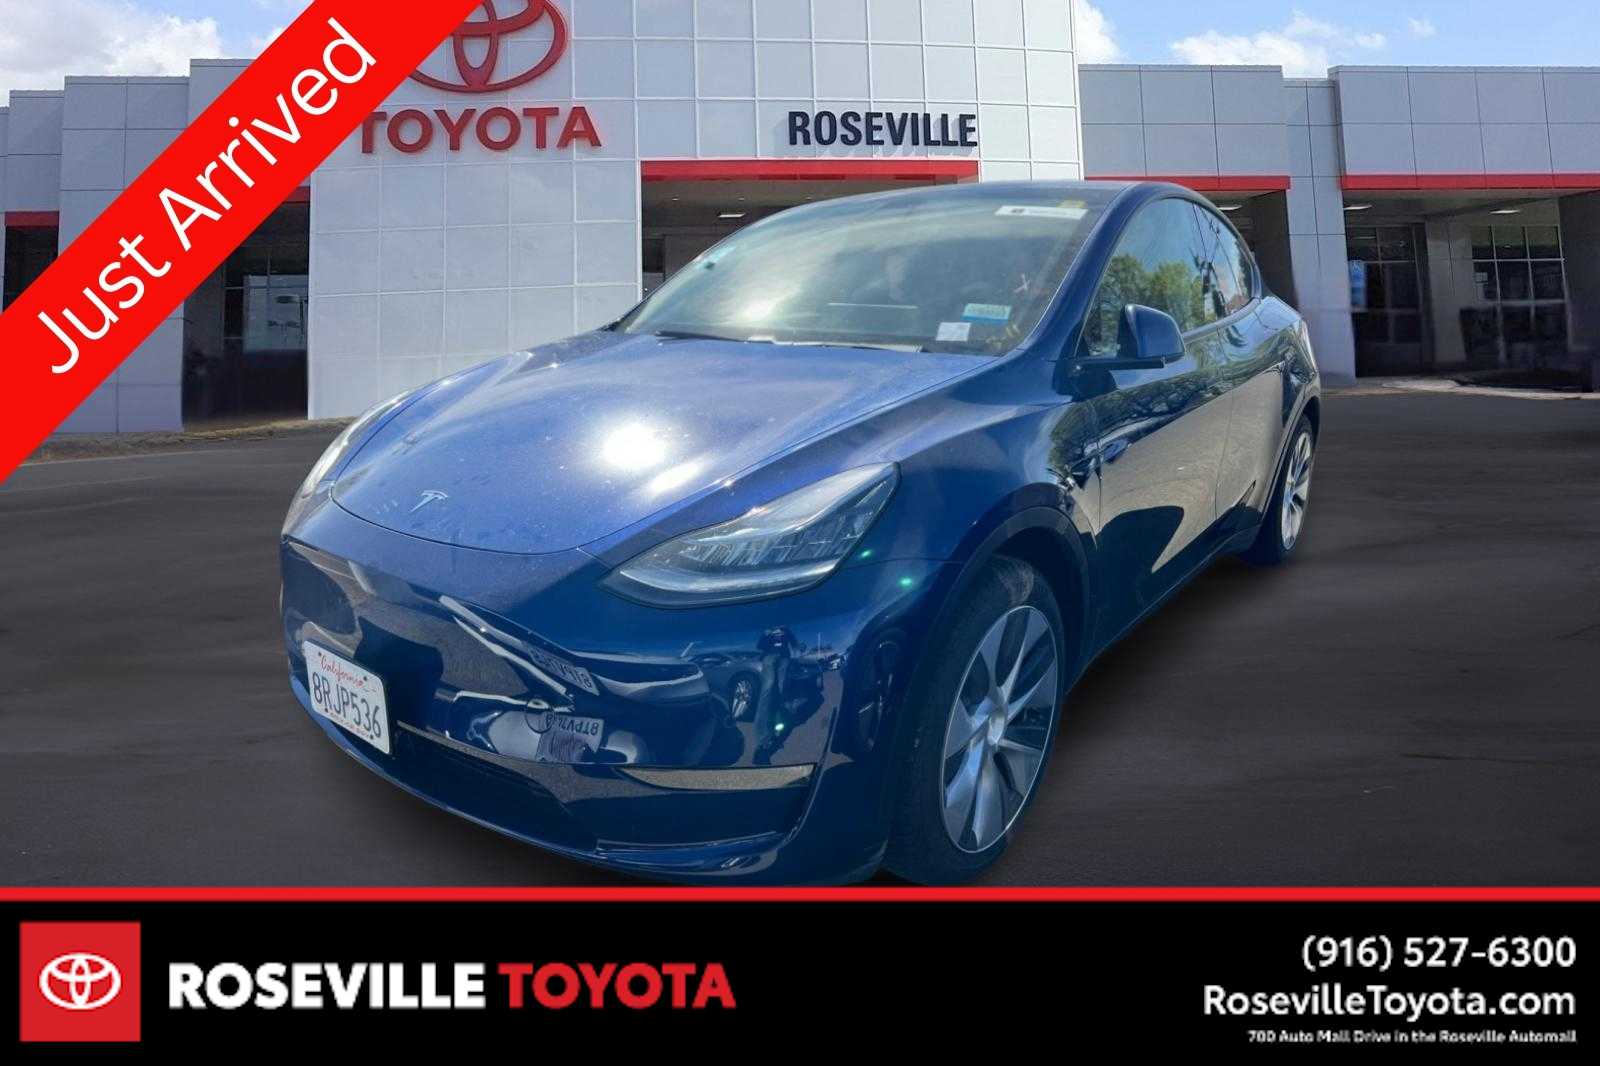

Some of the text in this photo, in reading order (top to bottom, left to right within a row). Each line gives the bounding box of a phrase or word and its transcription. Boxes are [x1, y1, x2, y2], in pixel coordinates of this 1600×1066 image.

[361, 106, 602, 154] TOYOTA
[788, 110, 978, 147] ROSEVILLE
[312, 671, 382, 738] 8RJP536
